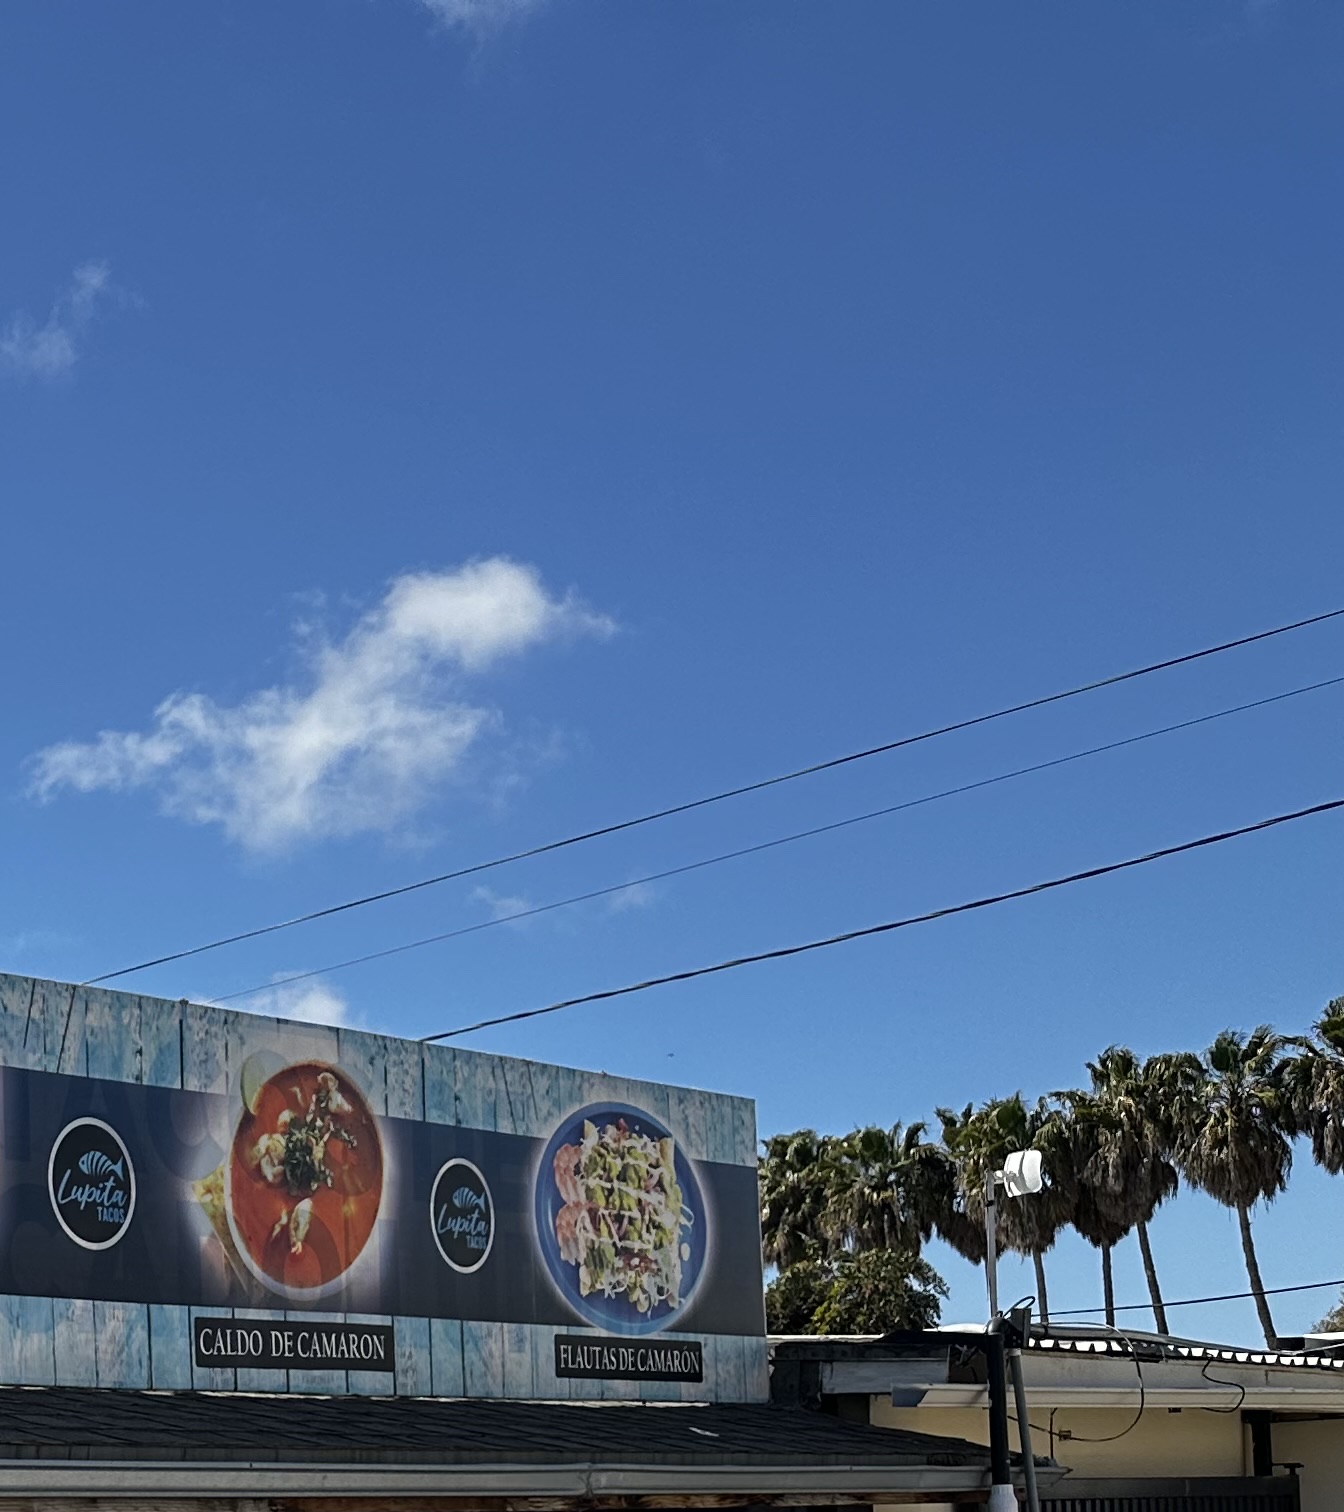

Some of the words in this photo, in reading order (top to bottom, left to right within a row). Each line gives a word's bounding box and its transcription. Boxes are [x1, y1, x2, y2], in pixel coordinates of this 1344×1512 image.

[58, 1169, 127, 1210] Lupita
[97, 1206, 125, 1223] TACOS
[437, 1203, 489, 1239] Lupita
[199, 1328, 263, 1356] CALDO
[270, 1330, 294, 1358] DE
[297, 1331, 385, 1360] CAMARON
[560, 1344, 617, 1370] FLAUTAS
[619, 1348, 636, 1371] DE
[637, 1345, 700, 1374] CAMARÓN
